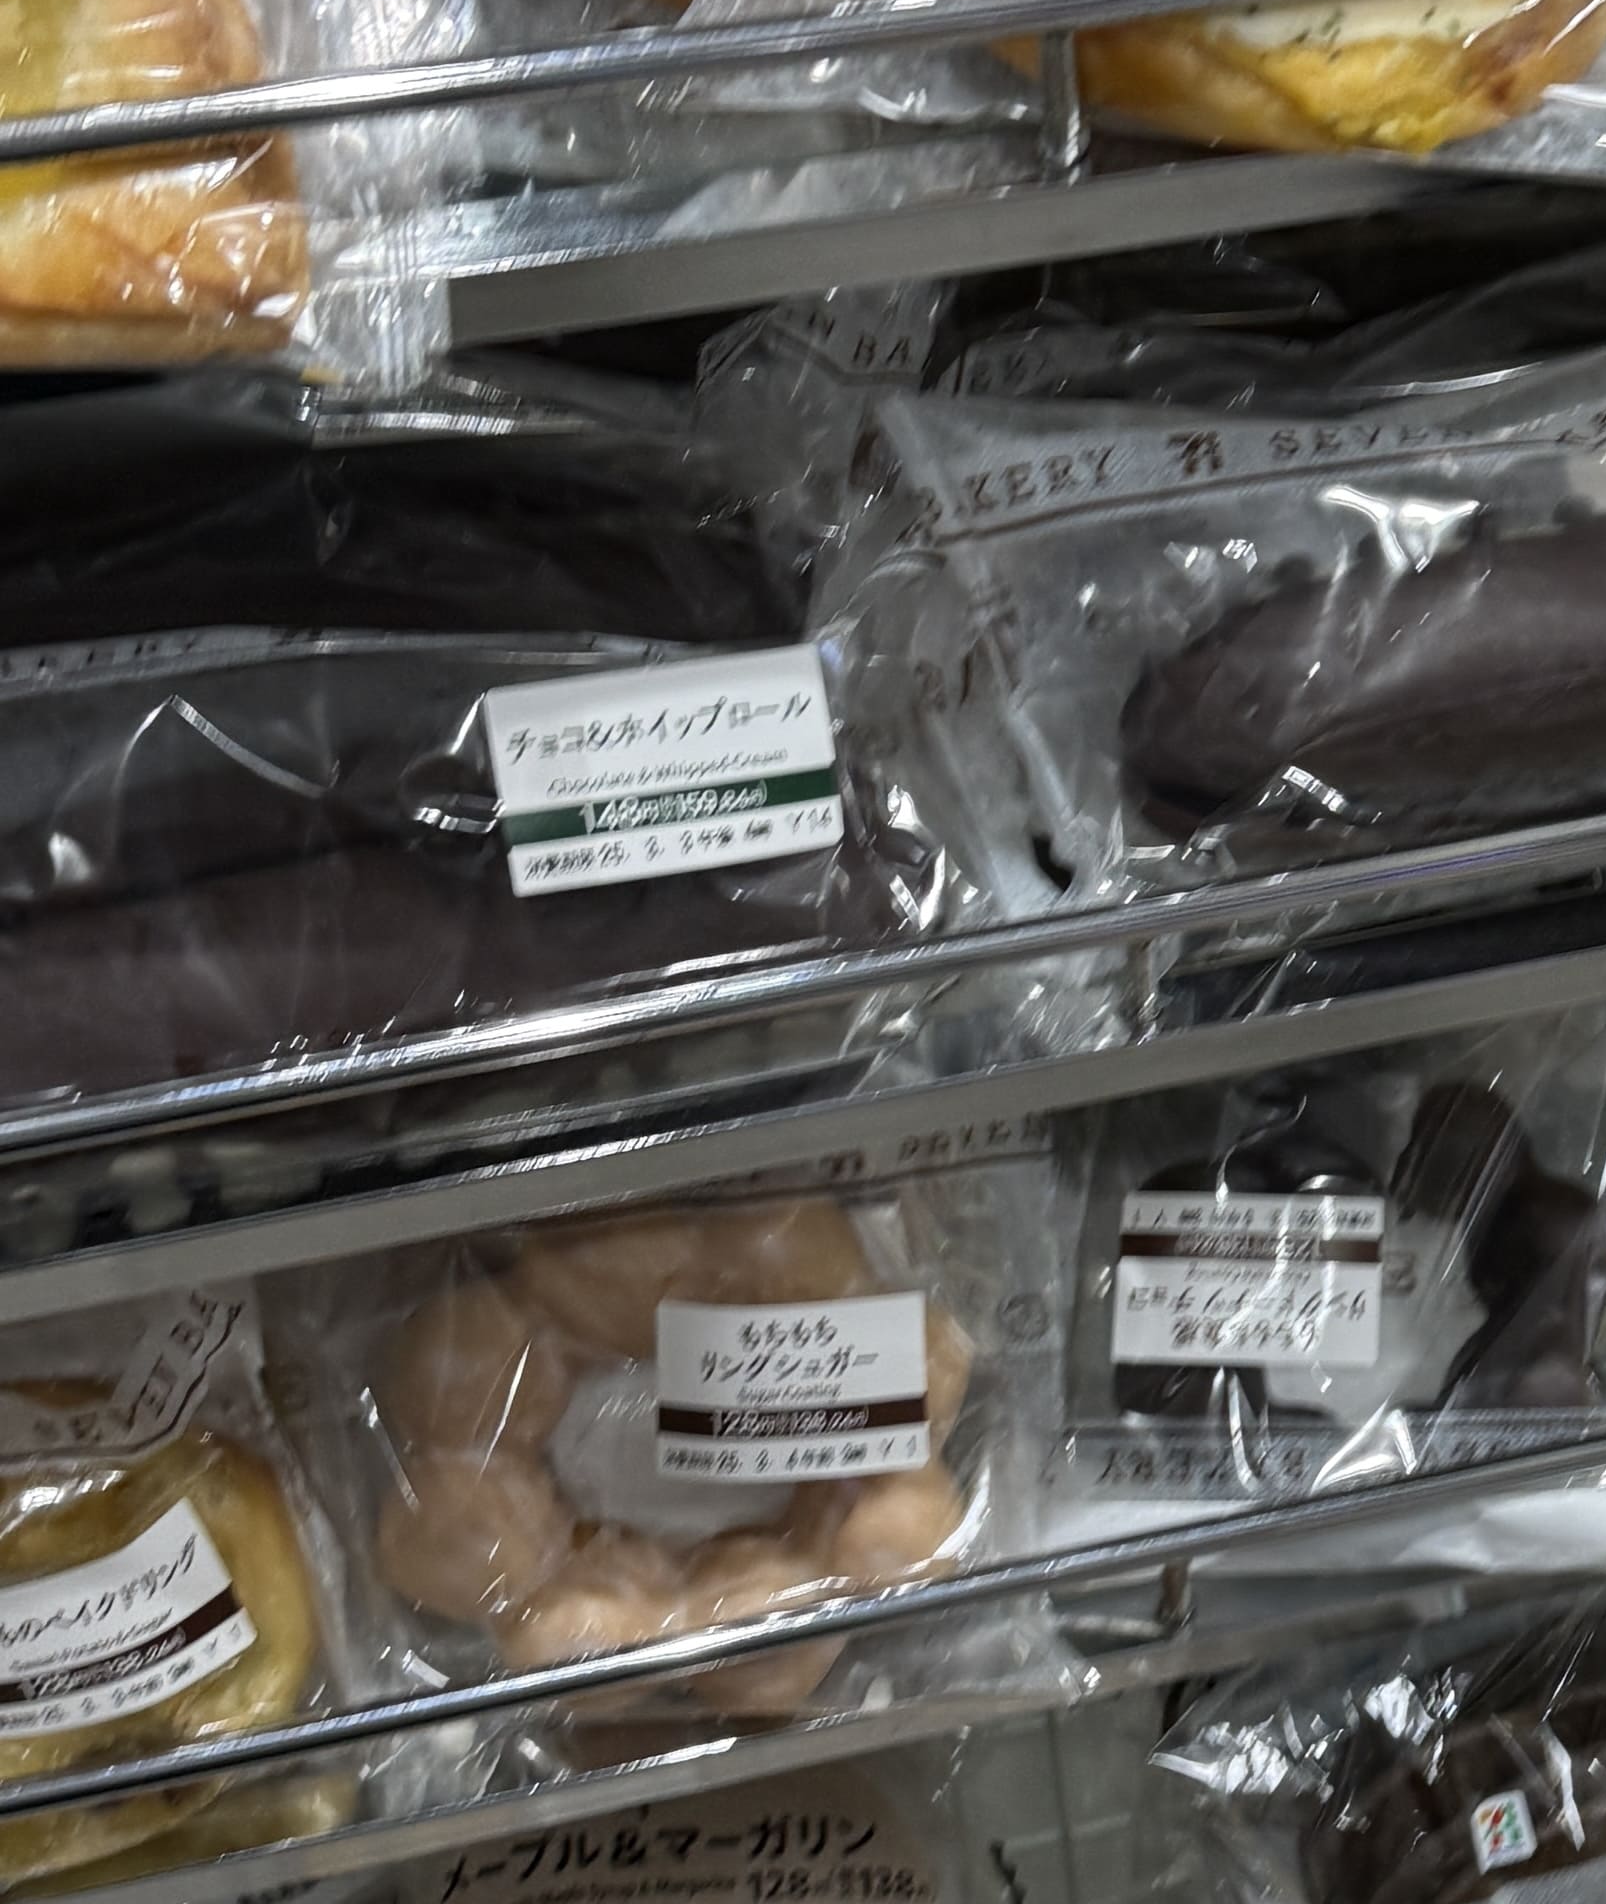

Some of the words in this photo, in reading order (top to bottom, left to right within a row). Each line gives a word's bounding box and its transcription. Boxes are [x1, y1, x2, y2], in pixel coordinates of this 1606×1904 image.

[738, 1317, 838, 1350] もちもち
[701, 1348, 879, 1382] リングシュガー
[441, 1814, 875, 1904] メープル&マーガリン
